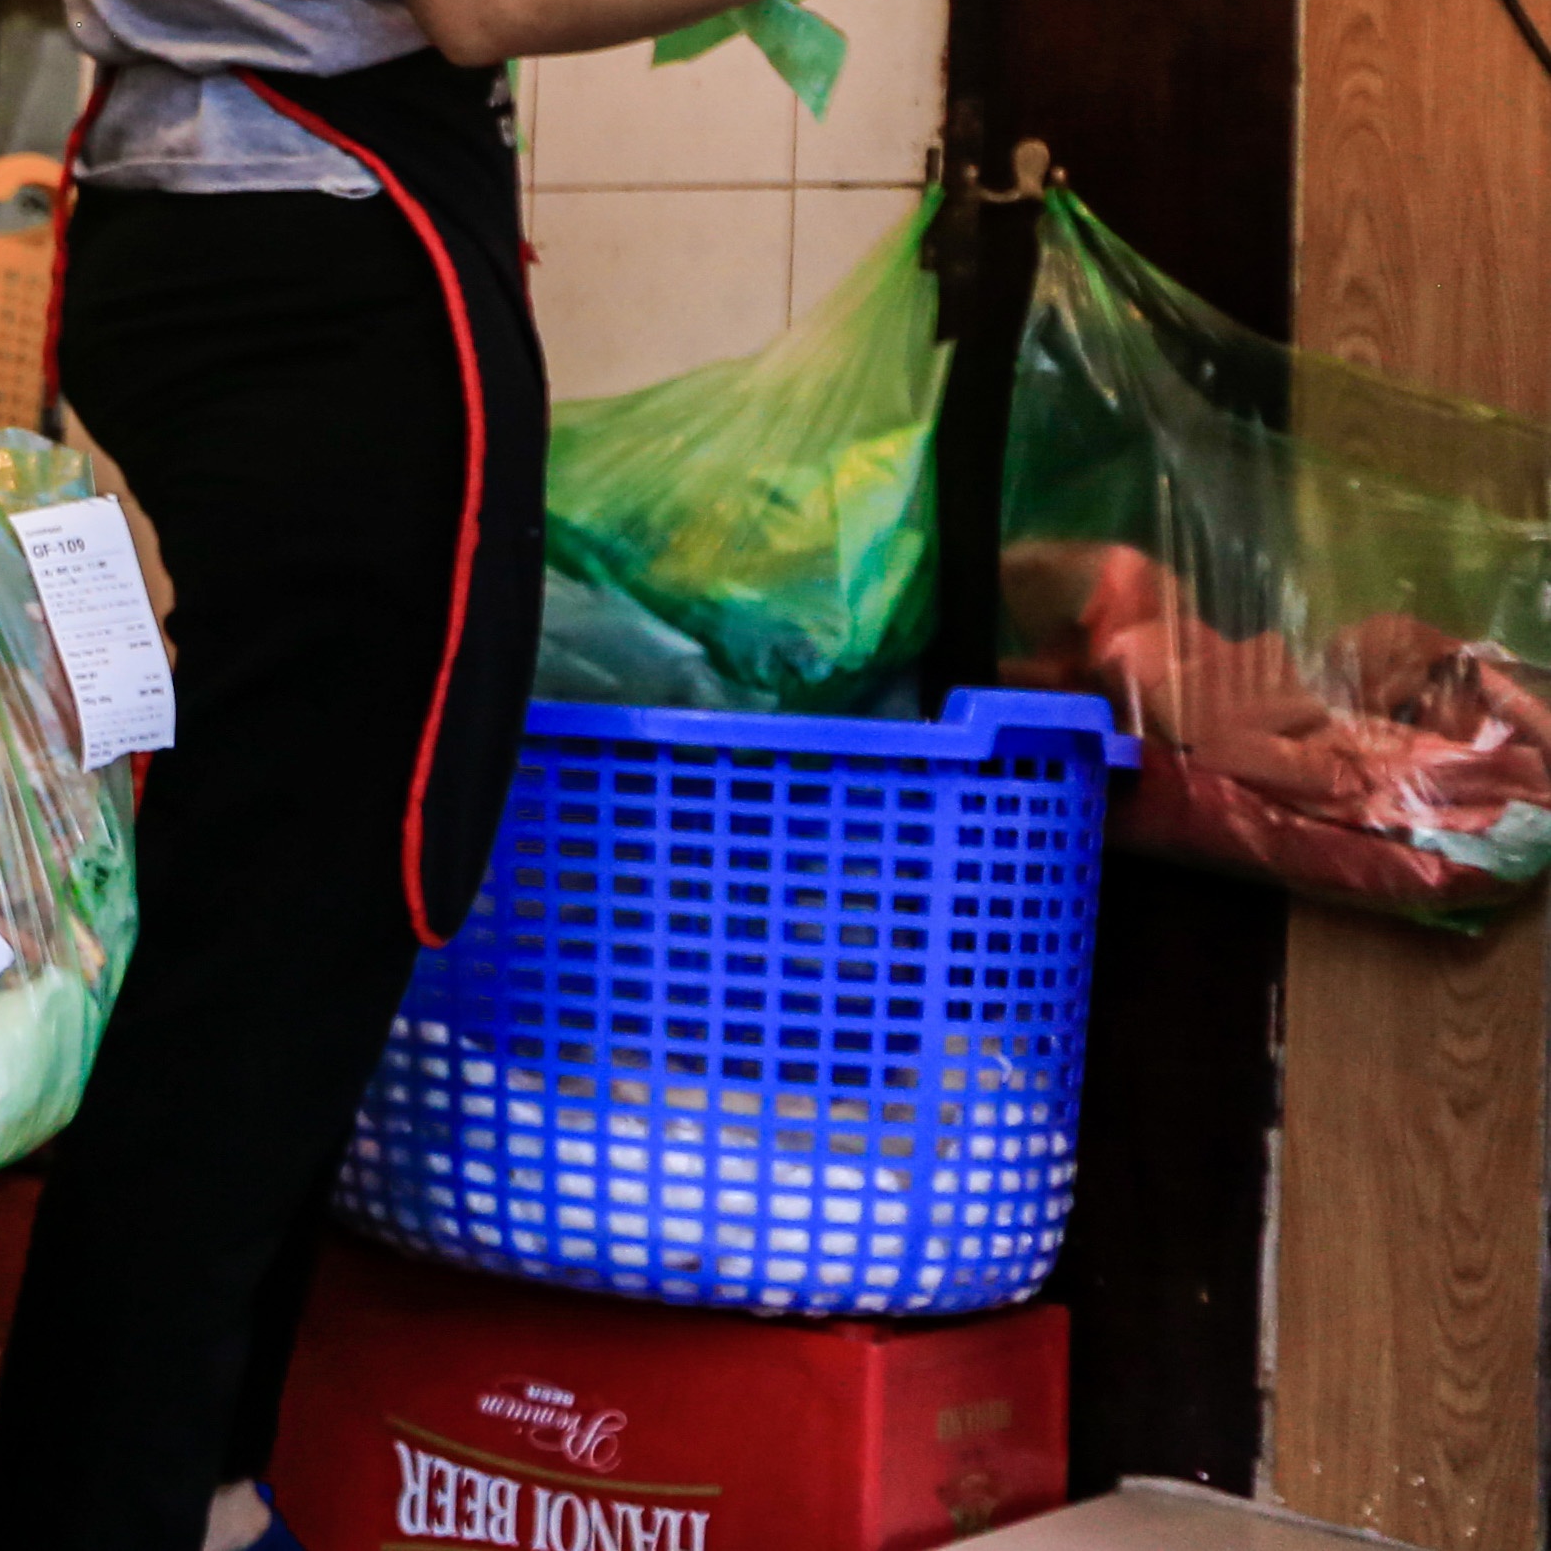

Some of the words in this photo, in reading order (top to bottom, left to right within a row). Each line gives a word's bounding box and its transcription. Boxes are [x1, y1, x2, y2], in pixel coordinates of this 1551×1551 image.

[33, 538, 85, 559] GF-109
[477, 1393, 627, 1473] Premium
[395, 1438, 522, 1547] BEER
